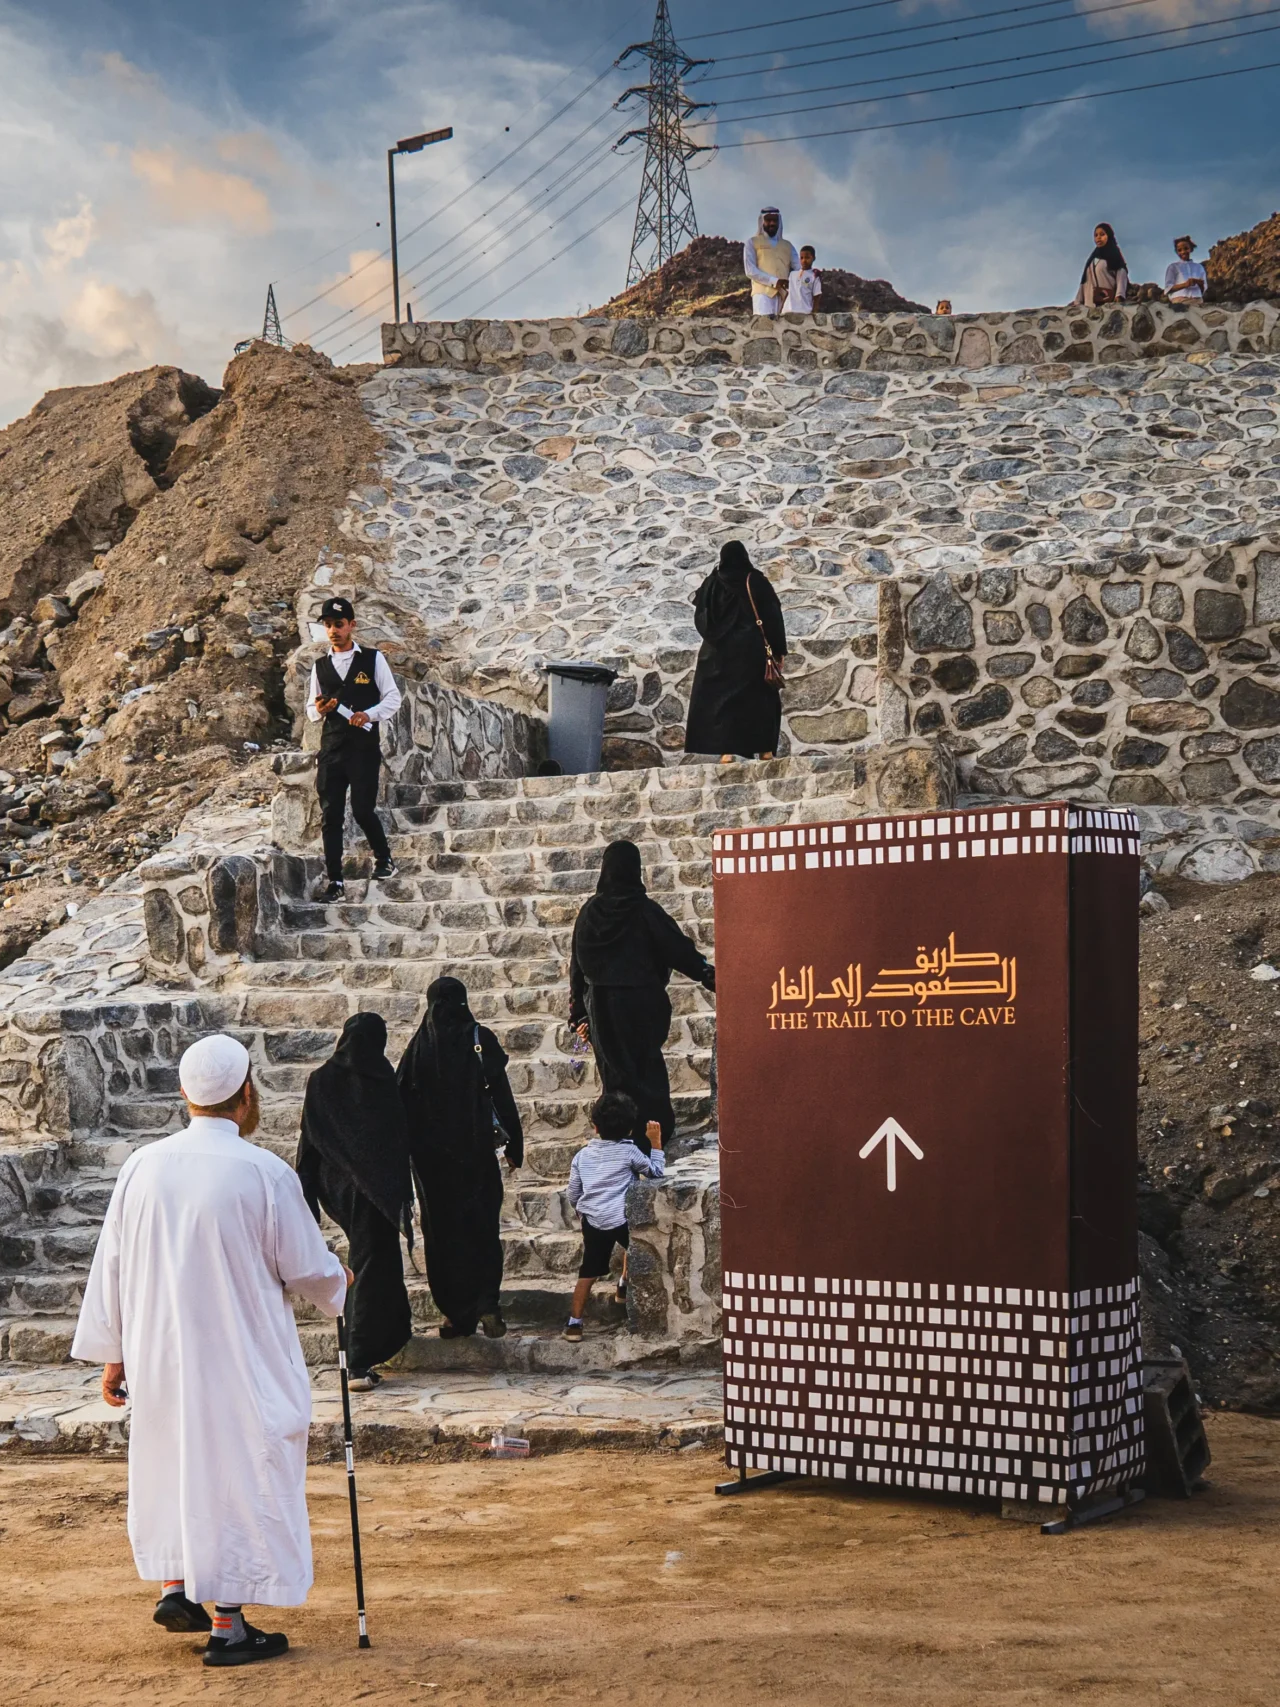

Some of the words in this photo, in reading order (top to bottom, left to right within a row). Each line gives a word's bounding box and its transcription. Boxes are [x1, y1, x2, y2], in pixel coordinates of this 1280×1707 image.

[877, 931, 1001, 977] طريق
[768, 964, 815, 1010] الغار
[814, 963, 862, 1007] إلى
[864, 956, 1017, 1006] الصعود
[766, 1012, 808, 1030] THE
[812, 1010, 872, 1029] TRAIL
[876, 1009, 907, 1028] TO
[911, 1008, 955, 1027] THE
[959, 1006, 1016, 1026] CAVE
